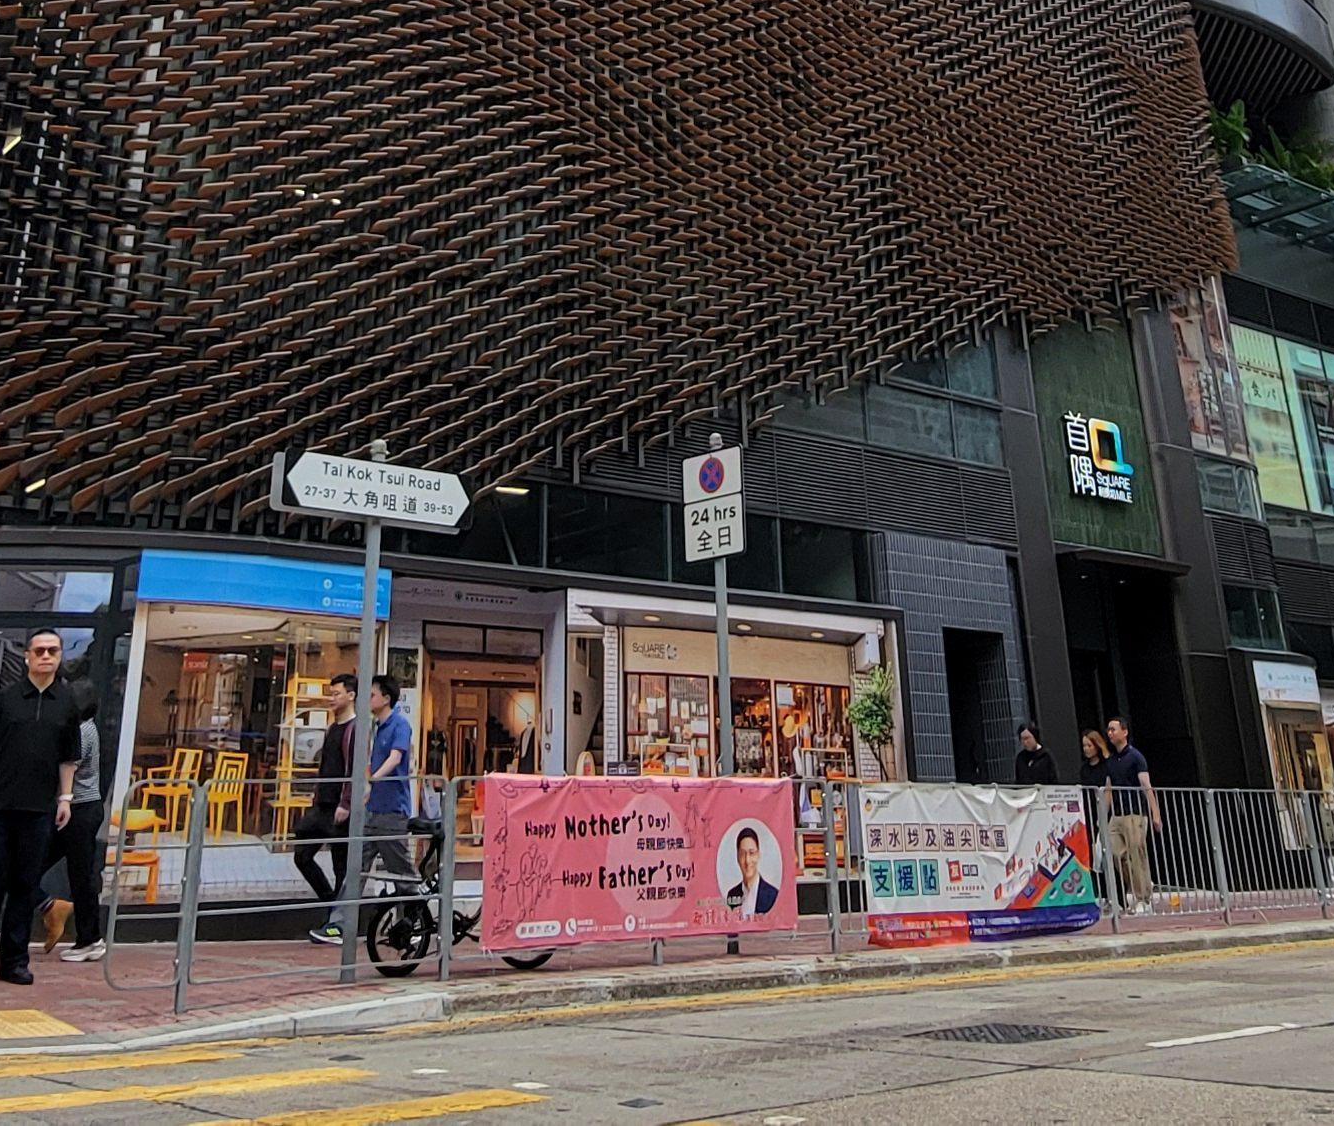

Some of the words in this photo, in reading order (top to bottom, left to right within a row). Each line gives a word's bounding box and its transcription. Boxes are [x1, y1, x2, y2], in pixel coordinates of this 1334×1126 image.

[1064, 410, 1097, 496] 首隅
[322, 461, 343, 477] Tai
[347, 465, 373, 482] Kok
[378, 469, 405, 486] Tsui
[408, 474, 441, 491] Road
[304, 486, 337, 499] 27-37
[343, 487, 418, 515] 大角咀道
[423, 502, 454, 516] 39-53
[691, 509, 709, 526] 24
[714, 505, 736, 522] hrs
[697, 525, 731, 553] 全日
[525, 820, 557, 839] Happy
[564, 810, 644, 840] Mother's
[647, 812, 671, 830] Day!
[869, 828, 1007, 848] 深水埗及油尖旺區
[636, 837, 685, 851] 母親節快樂
[562, 869, 593, 888] Happy
[598, 860, 672, 890] Father's
[675, 861, 695, 881] Day!
[636, 886, 686, 901] 父親節快樂
